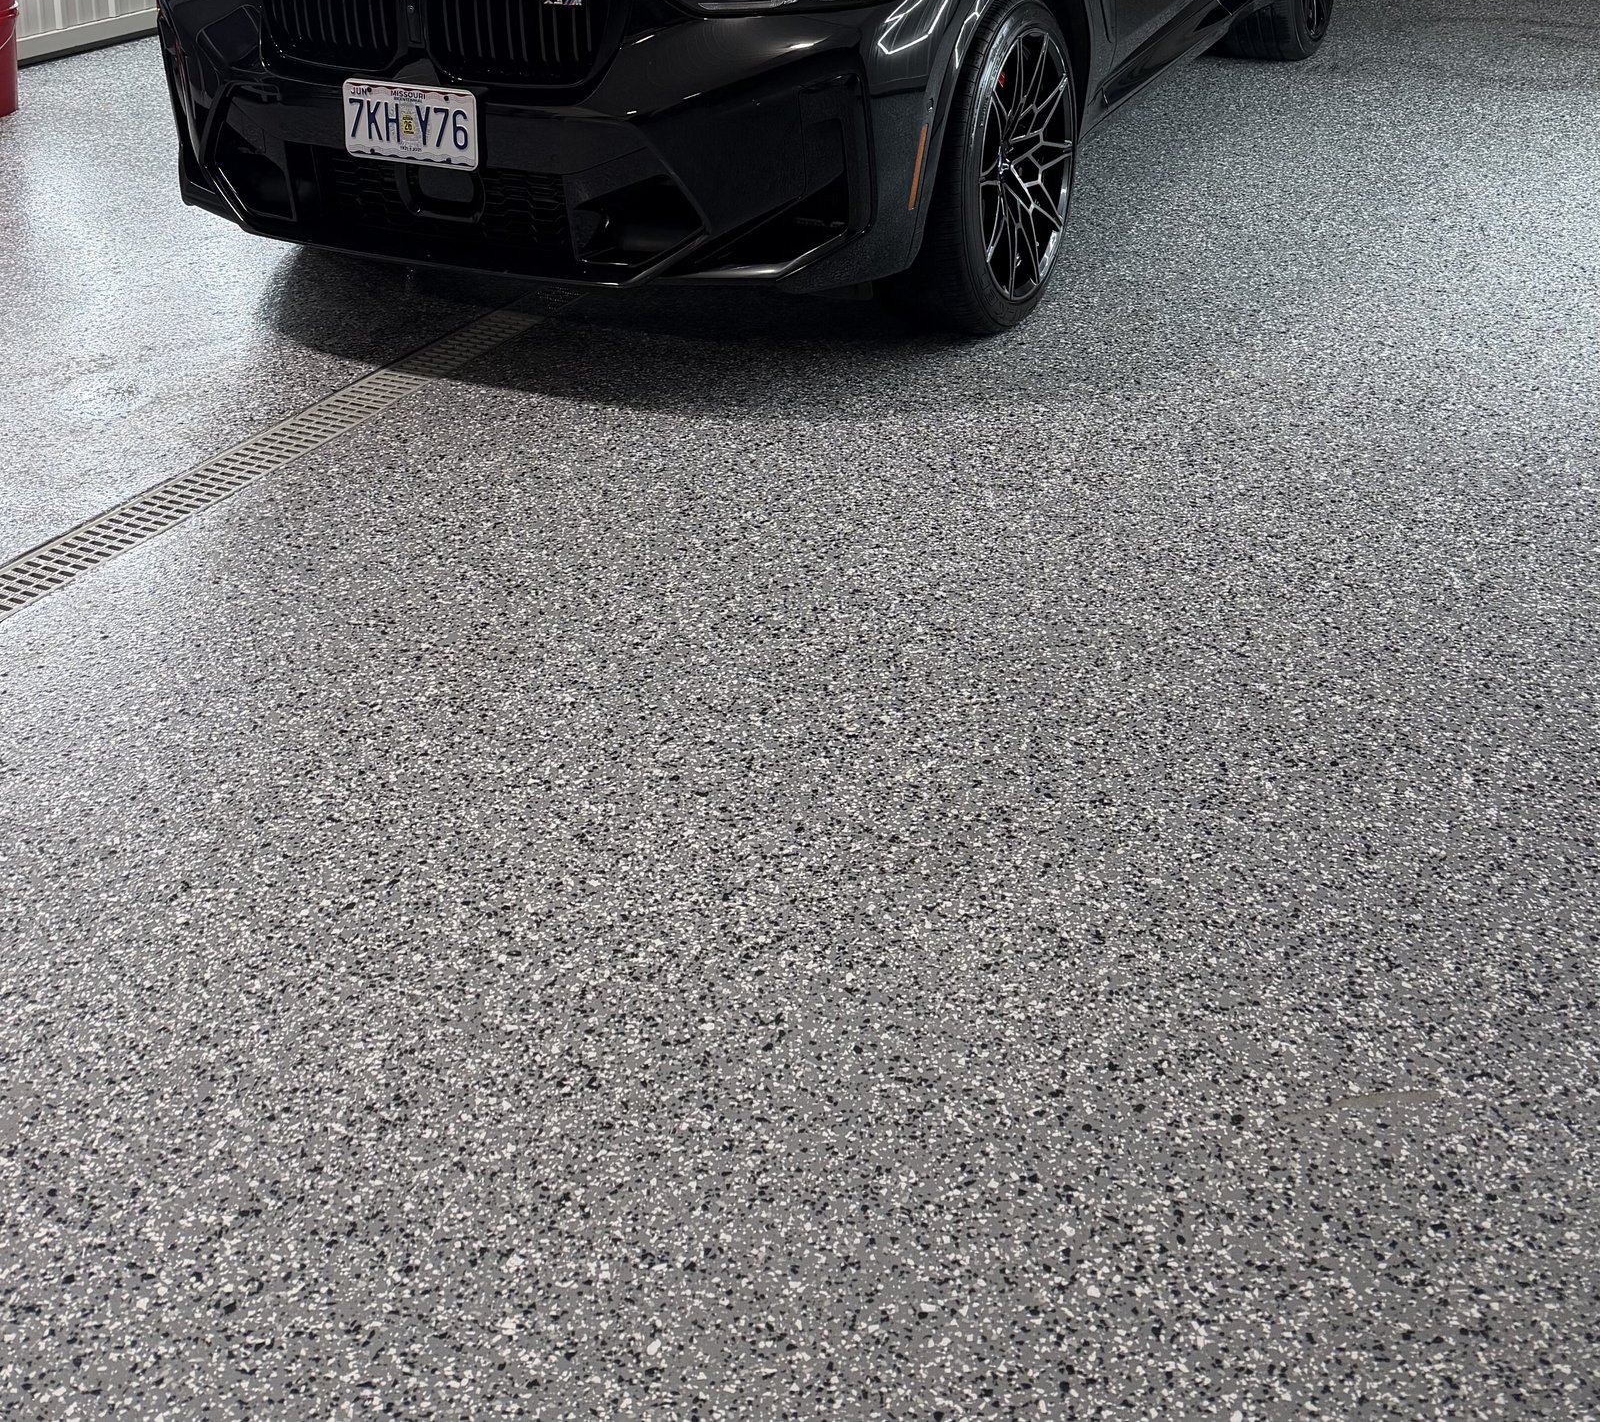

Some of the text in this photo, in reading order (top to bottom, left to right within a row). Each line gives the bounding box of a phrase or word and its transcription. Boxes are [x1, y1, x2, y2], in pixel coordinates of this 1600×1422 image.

[350, 87, 367, 96] JUN
[390, 89, 426, 100] MISSOURI
[348, 97, 469, 150] 7KH Y76
[404, 120, 413, 131] 26
